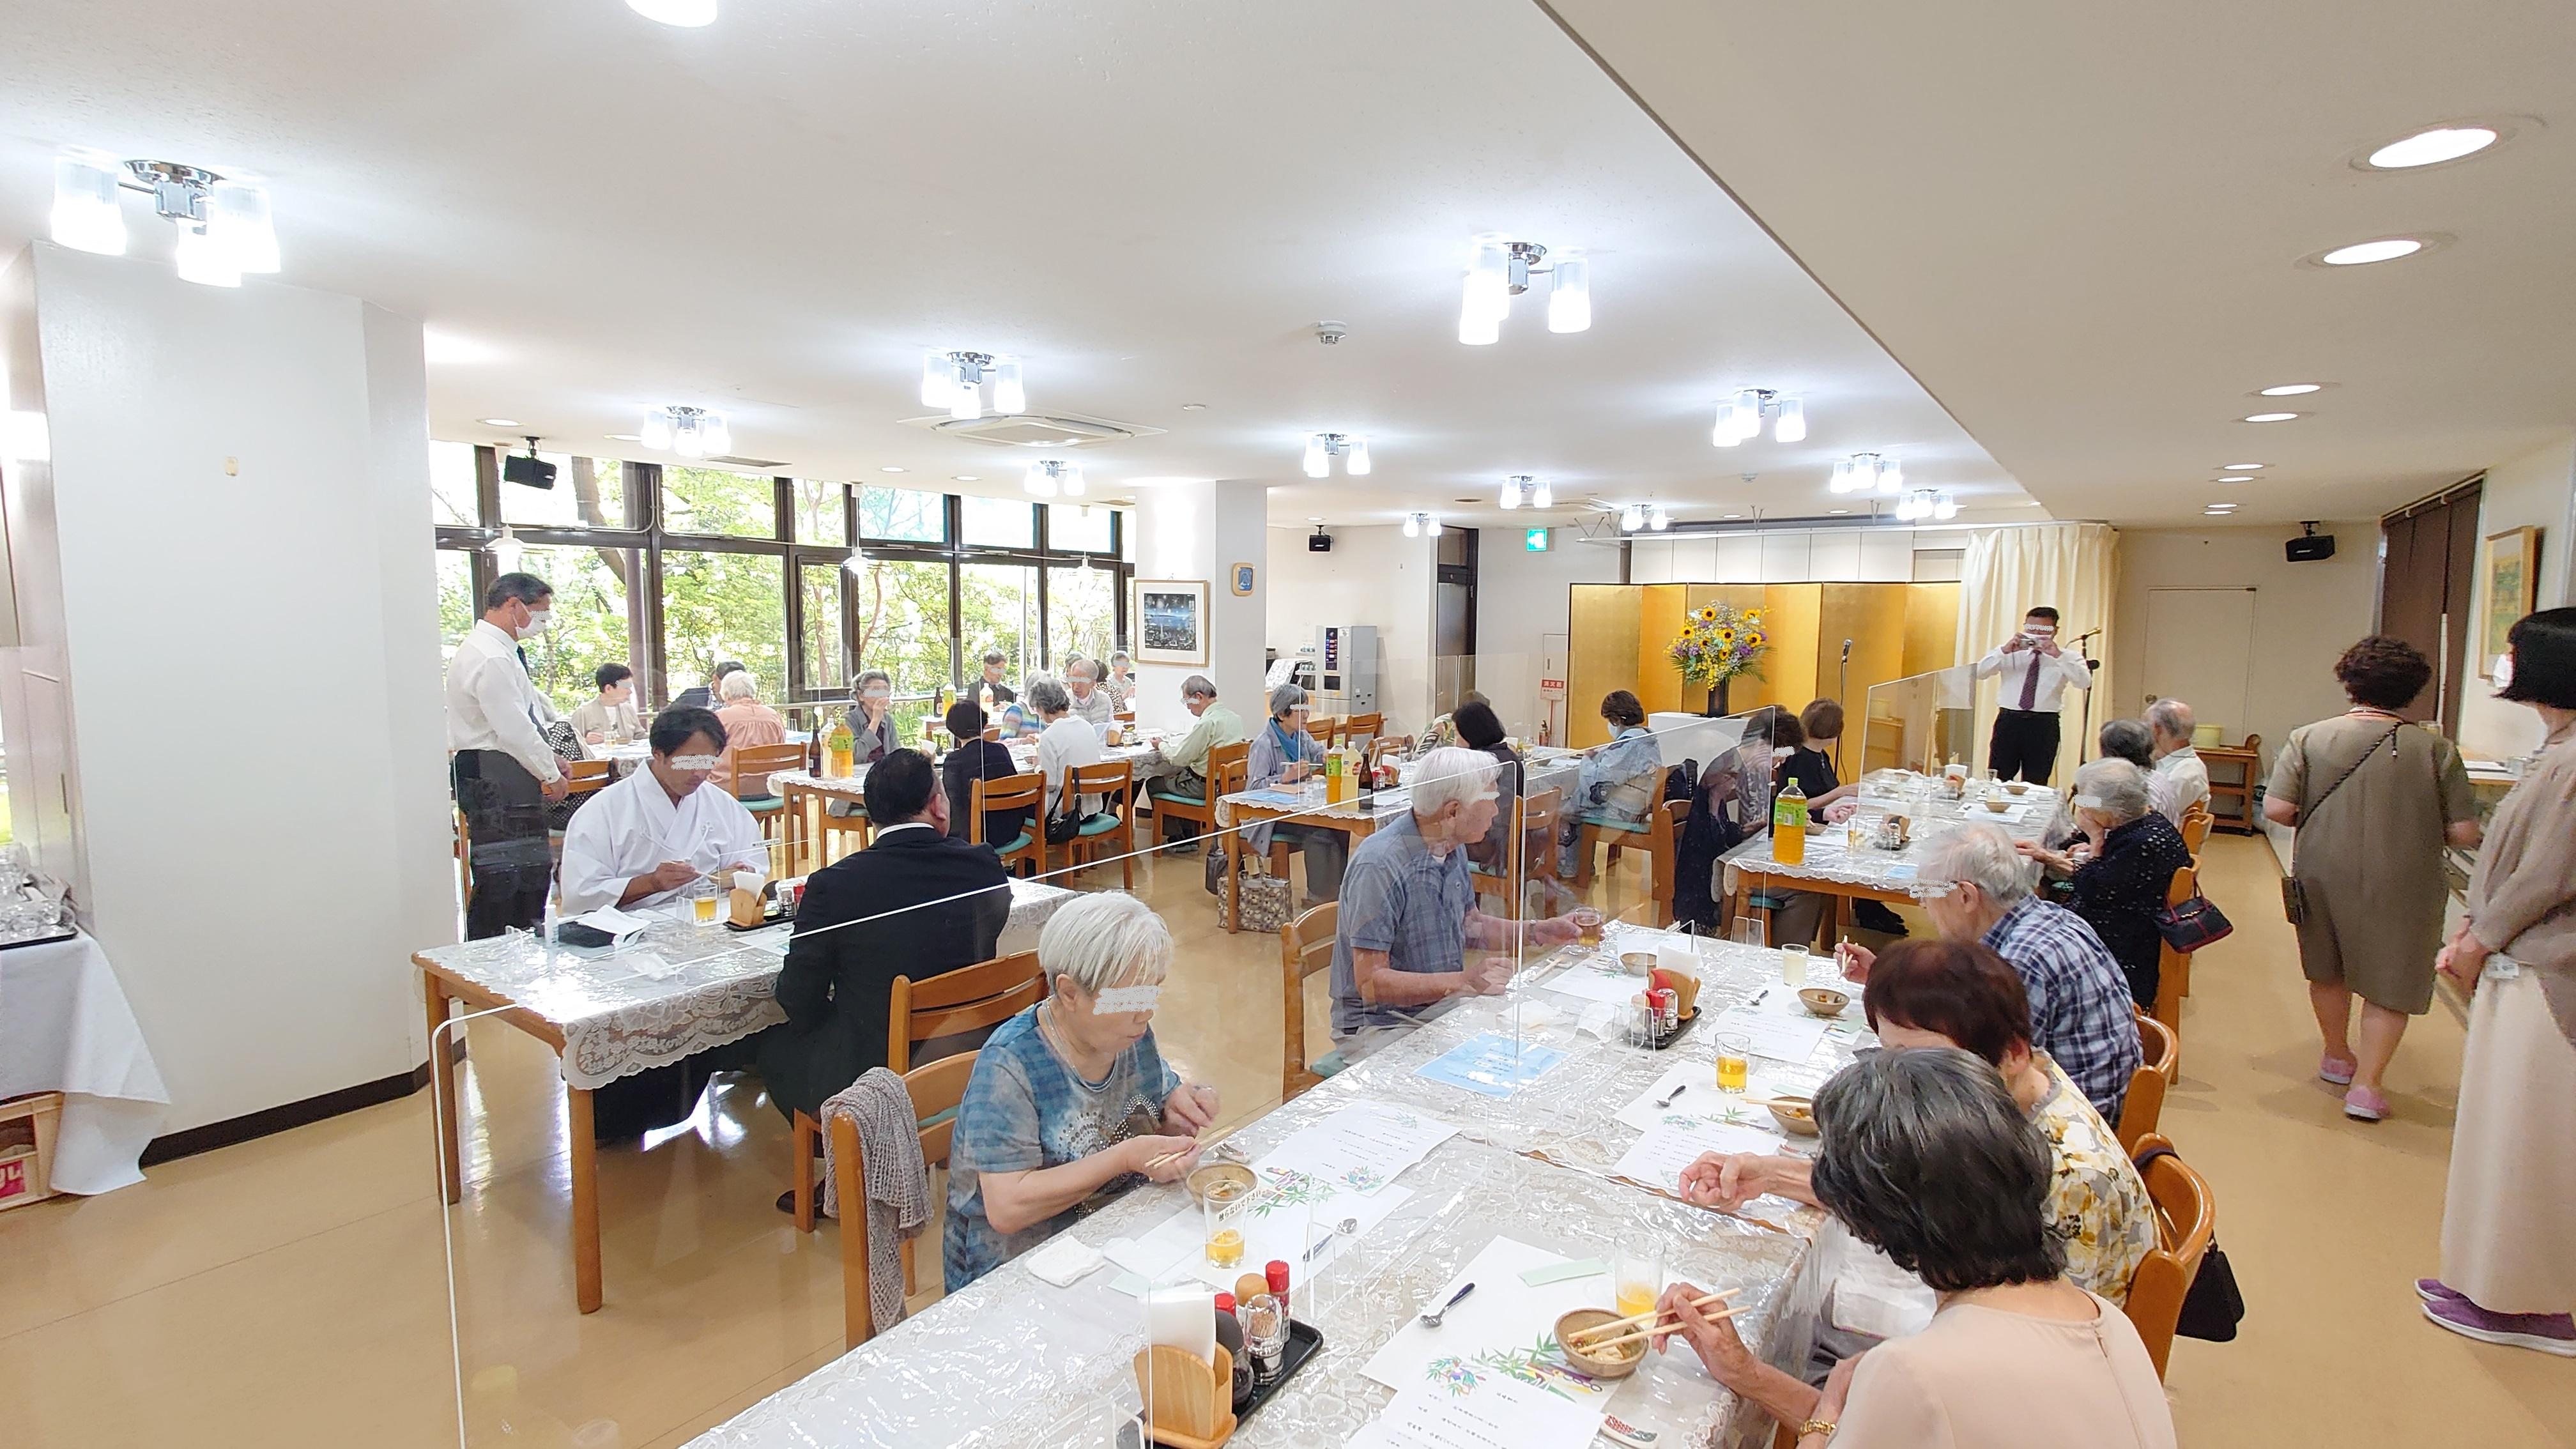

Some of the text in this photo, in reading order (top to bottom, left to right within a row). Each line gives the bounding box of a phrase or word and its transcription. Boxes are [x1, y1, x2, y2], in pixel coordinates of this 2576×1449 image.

[1218, 1190, 1261, 1222] 触らないで下さい
